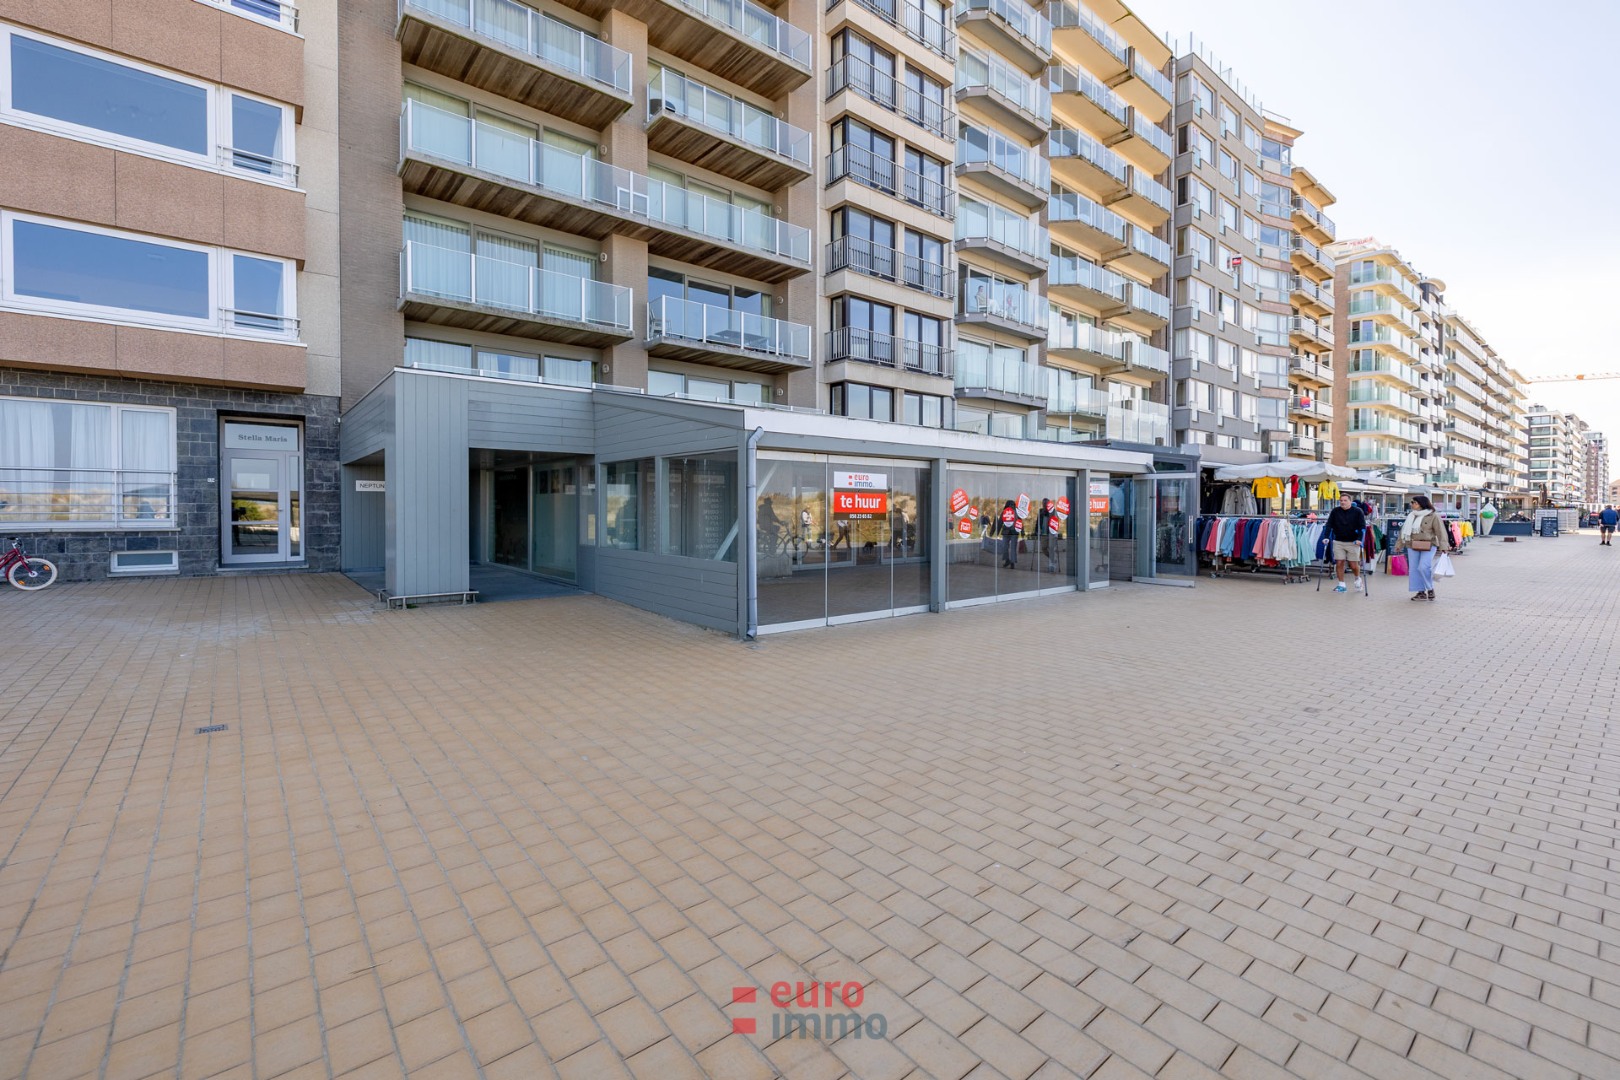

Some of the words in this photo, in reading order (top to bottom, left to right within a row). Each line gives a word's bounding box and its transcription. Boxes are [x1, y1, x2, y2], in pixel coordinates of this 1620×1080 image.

[840, 495, 853, 508] te
[855, 493, 881, 509] huur
[1092, 499, 1107, 509] huur
